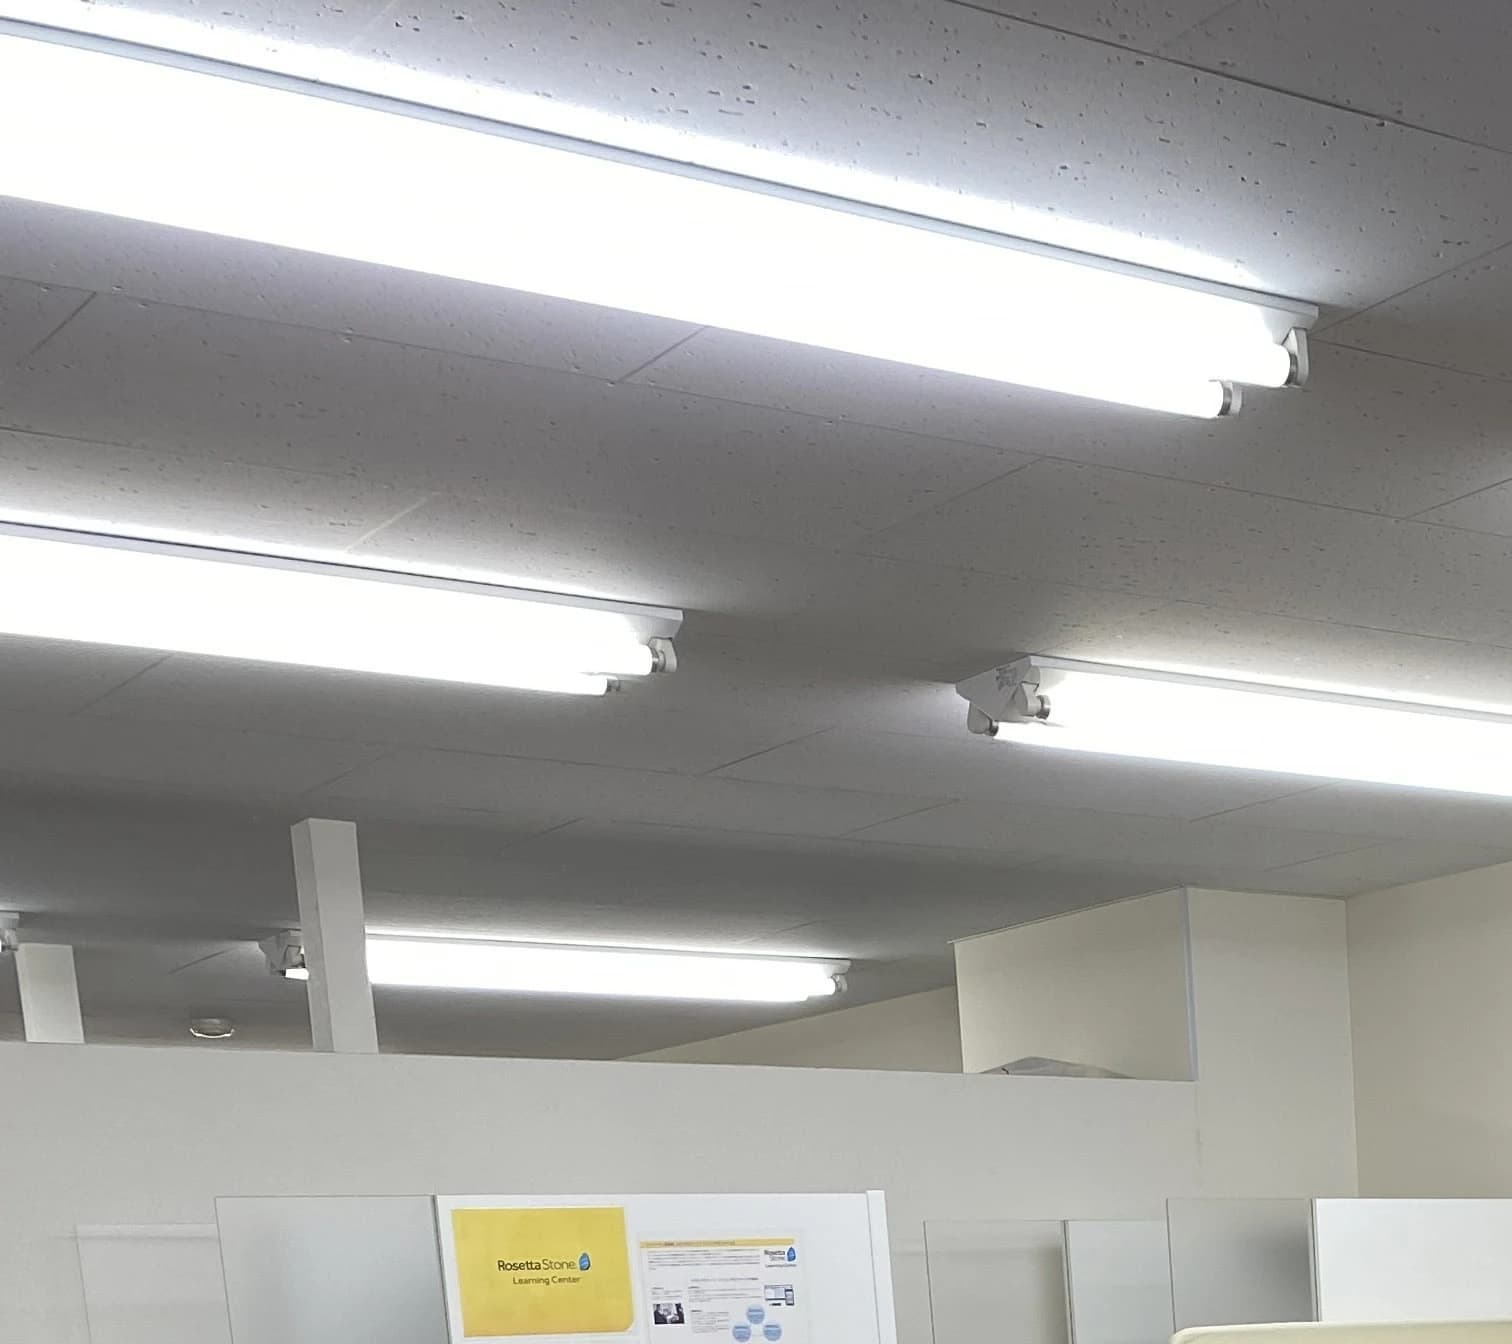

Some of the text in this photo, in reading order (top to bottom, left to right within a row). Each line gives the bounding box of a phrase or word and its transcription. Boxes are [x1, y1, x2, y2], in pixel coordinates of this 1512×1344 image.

[498, 1259, 577, 1271] Rosetta Stone
[513, 1276, 550, 1285] Learning
